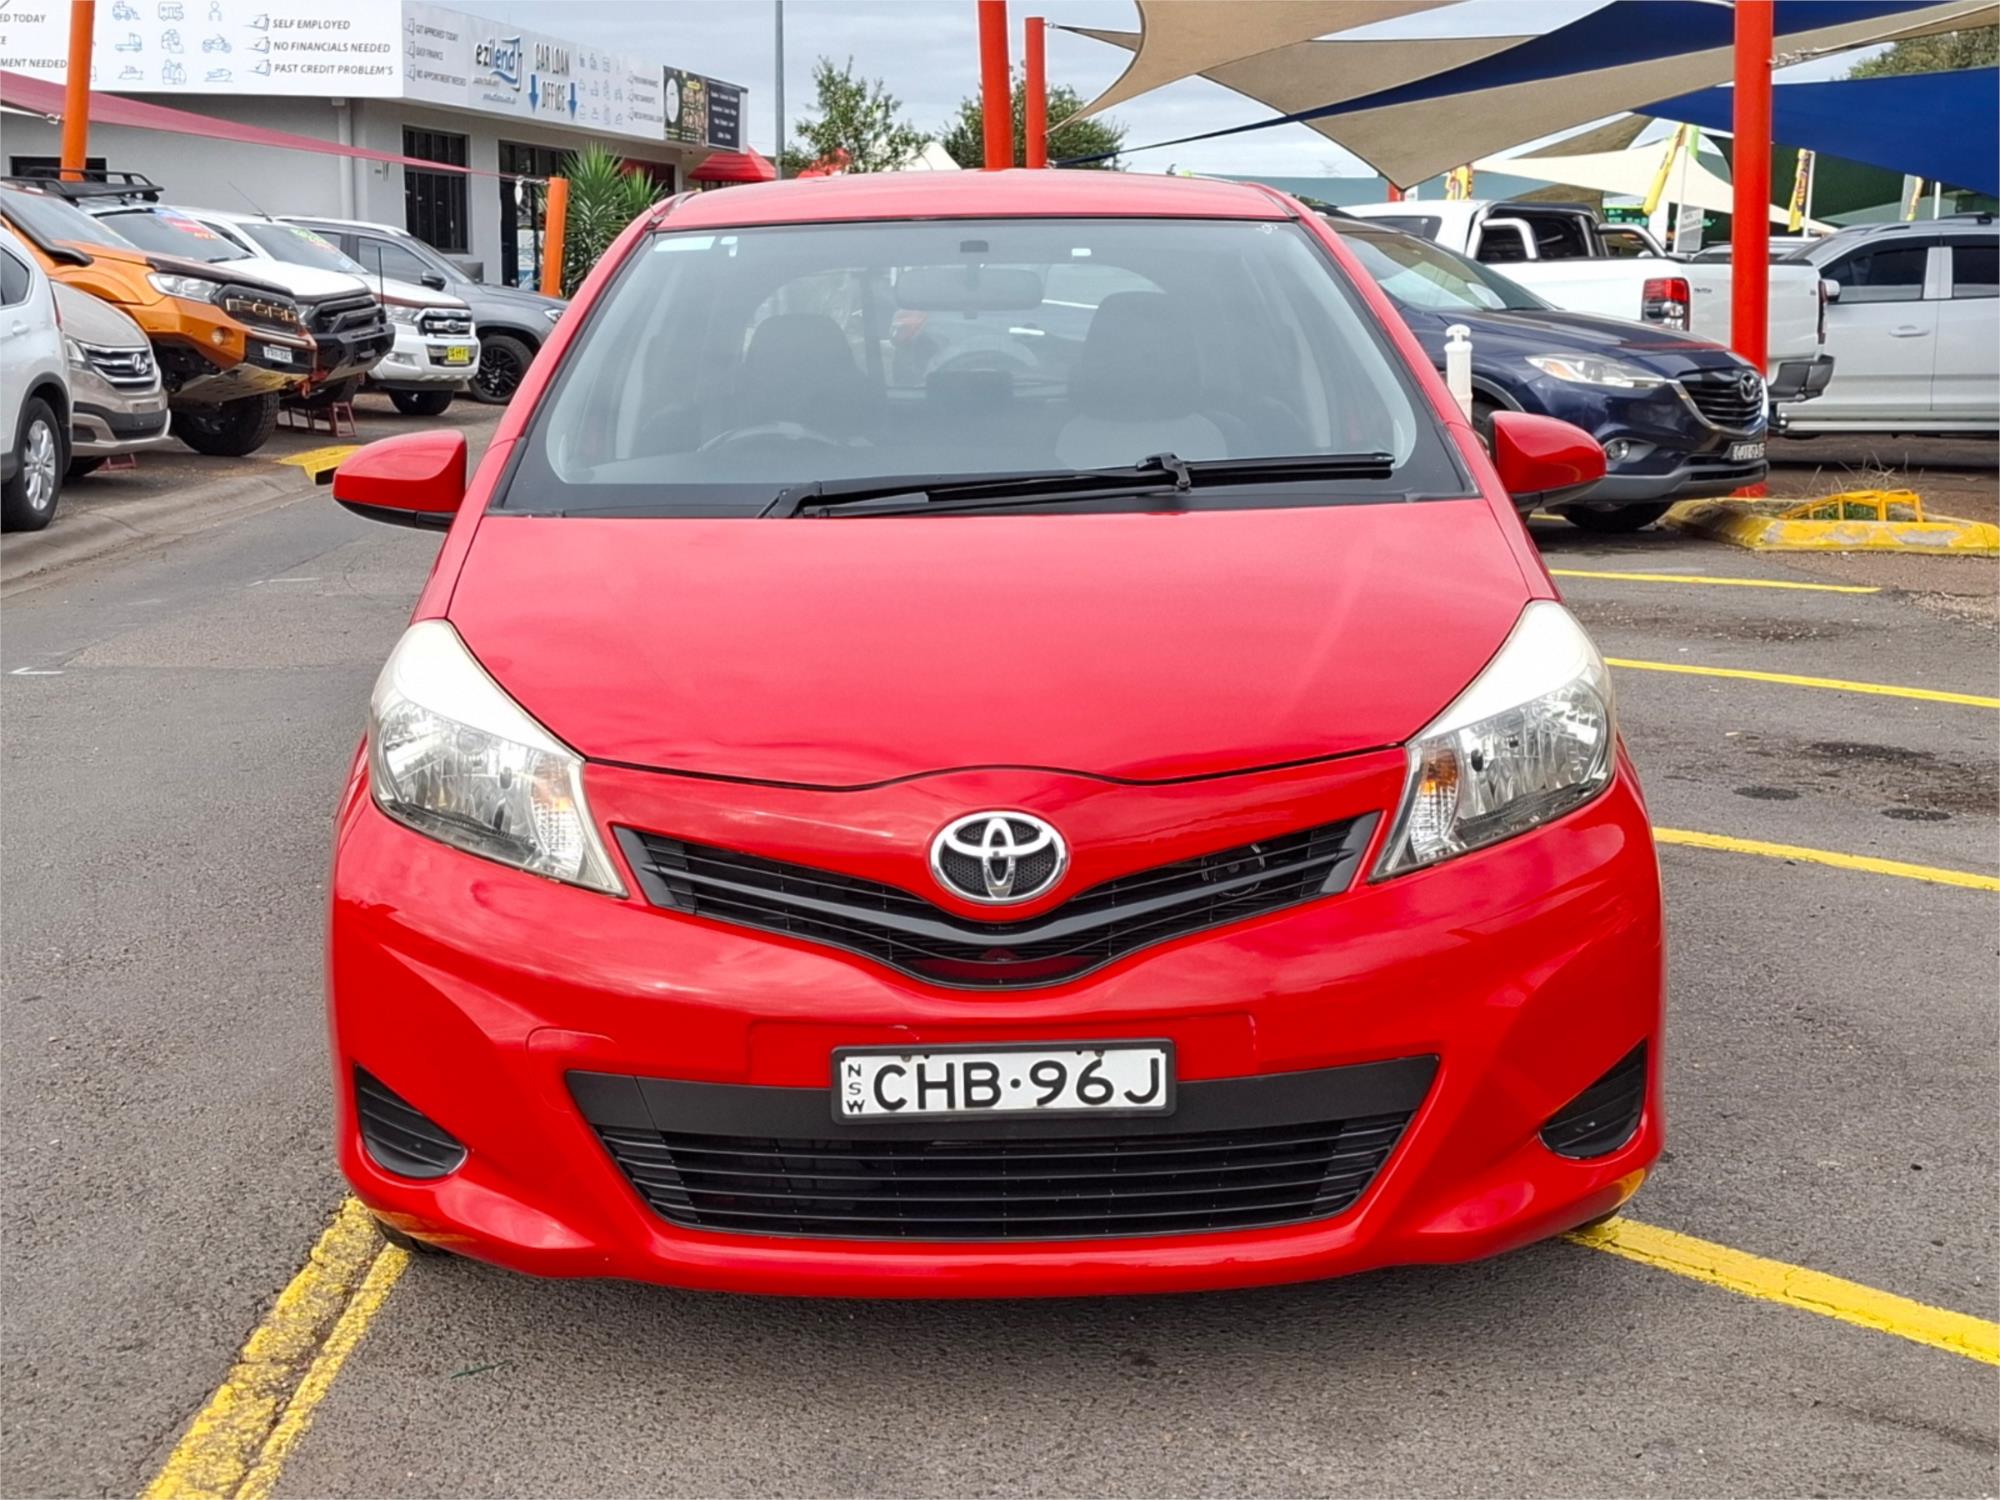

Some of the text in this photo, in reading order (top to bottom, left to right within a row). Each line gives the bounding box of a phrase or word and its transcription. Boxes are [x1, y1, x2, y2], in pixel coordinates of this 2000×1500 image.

[13, 13, 47, 23] TODAY
[272, 19, 351, 30] SELF EMPLOYED
[273, 41, 391, 53] NO FINANCIALS NEEDED
[28, 58, 68, 69] NEEDED
[274, 63, 394, 76] PAST CREDIT PROBLEM'S
